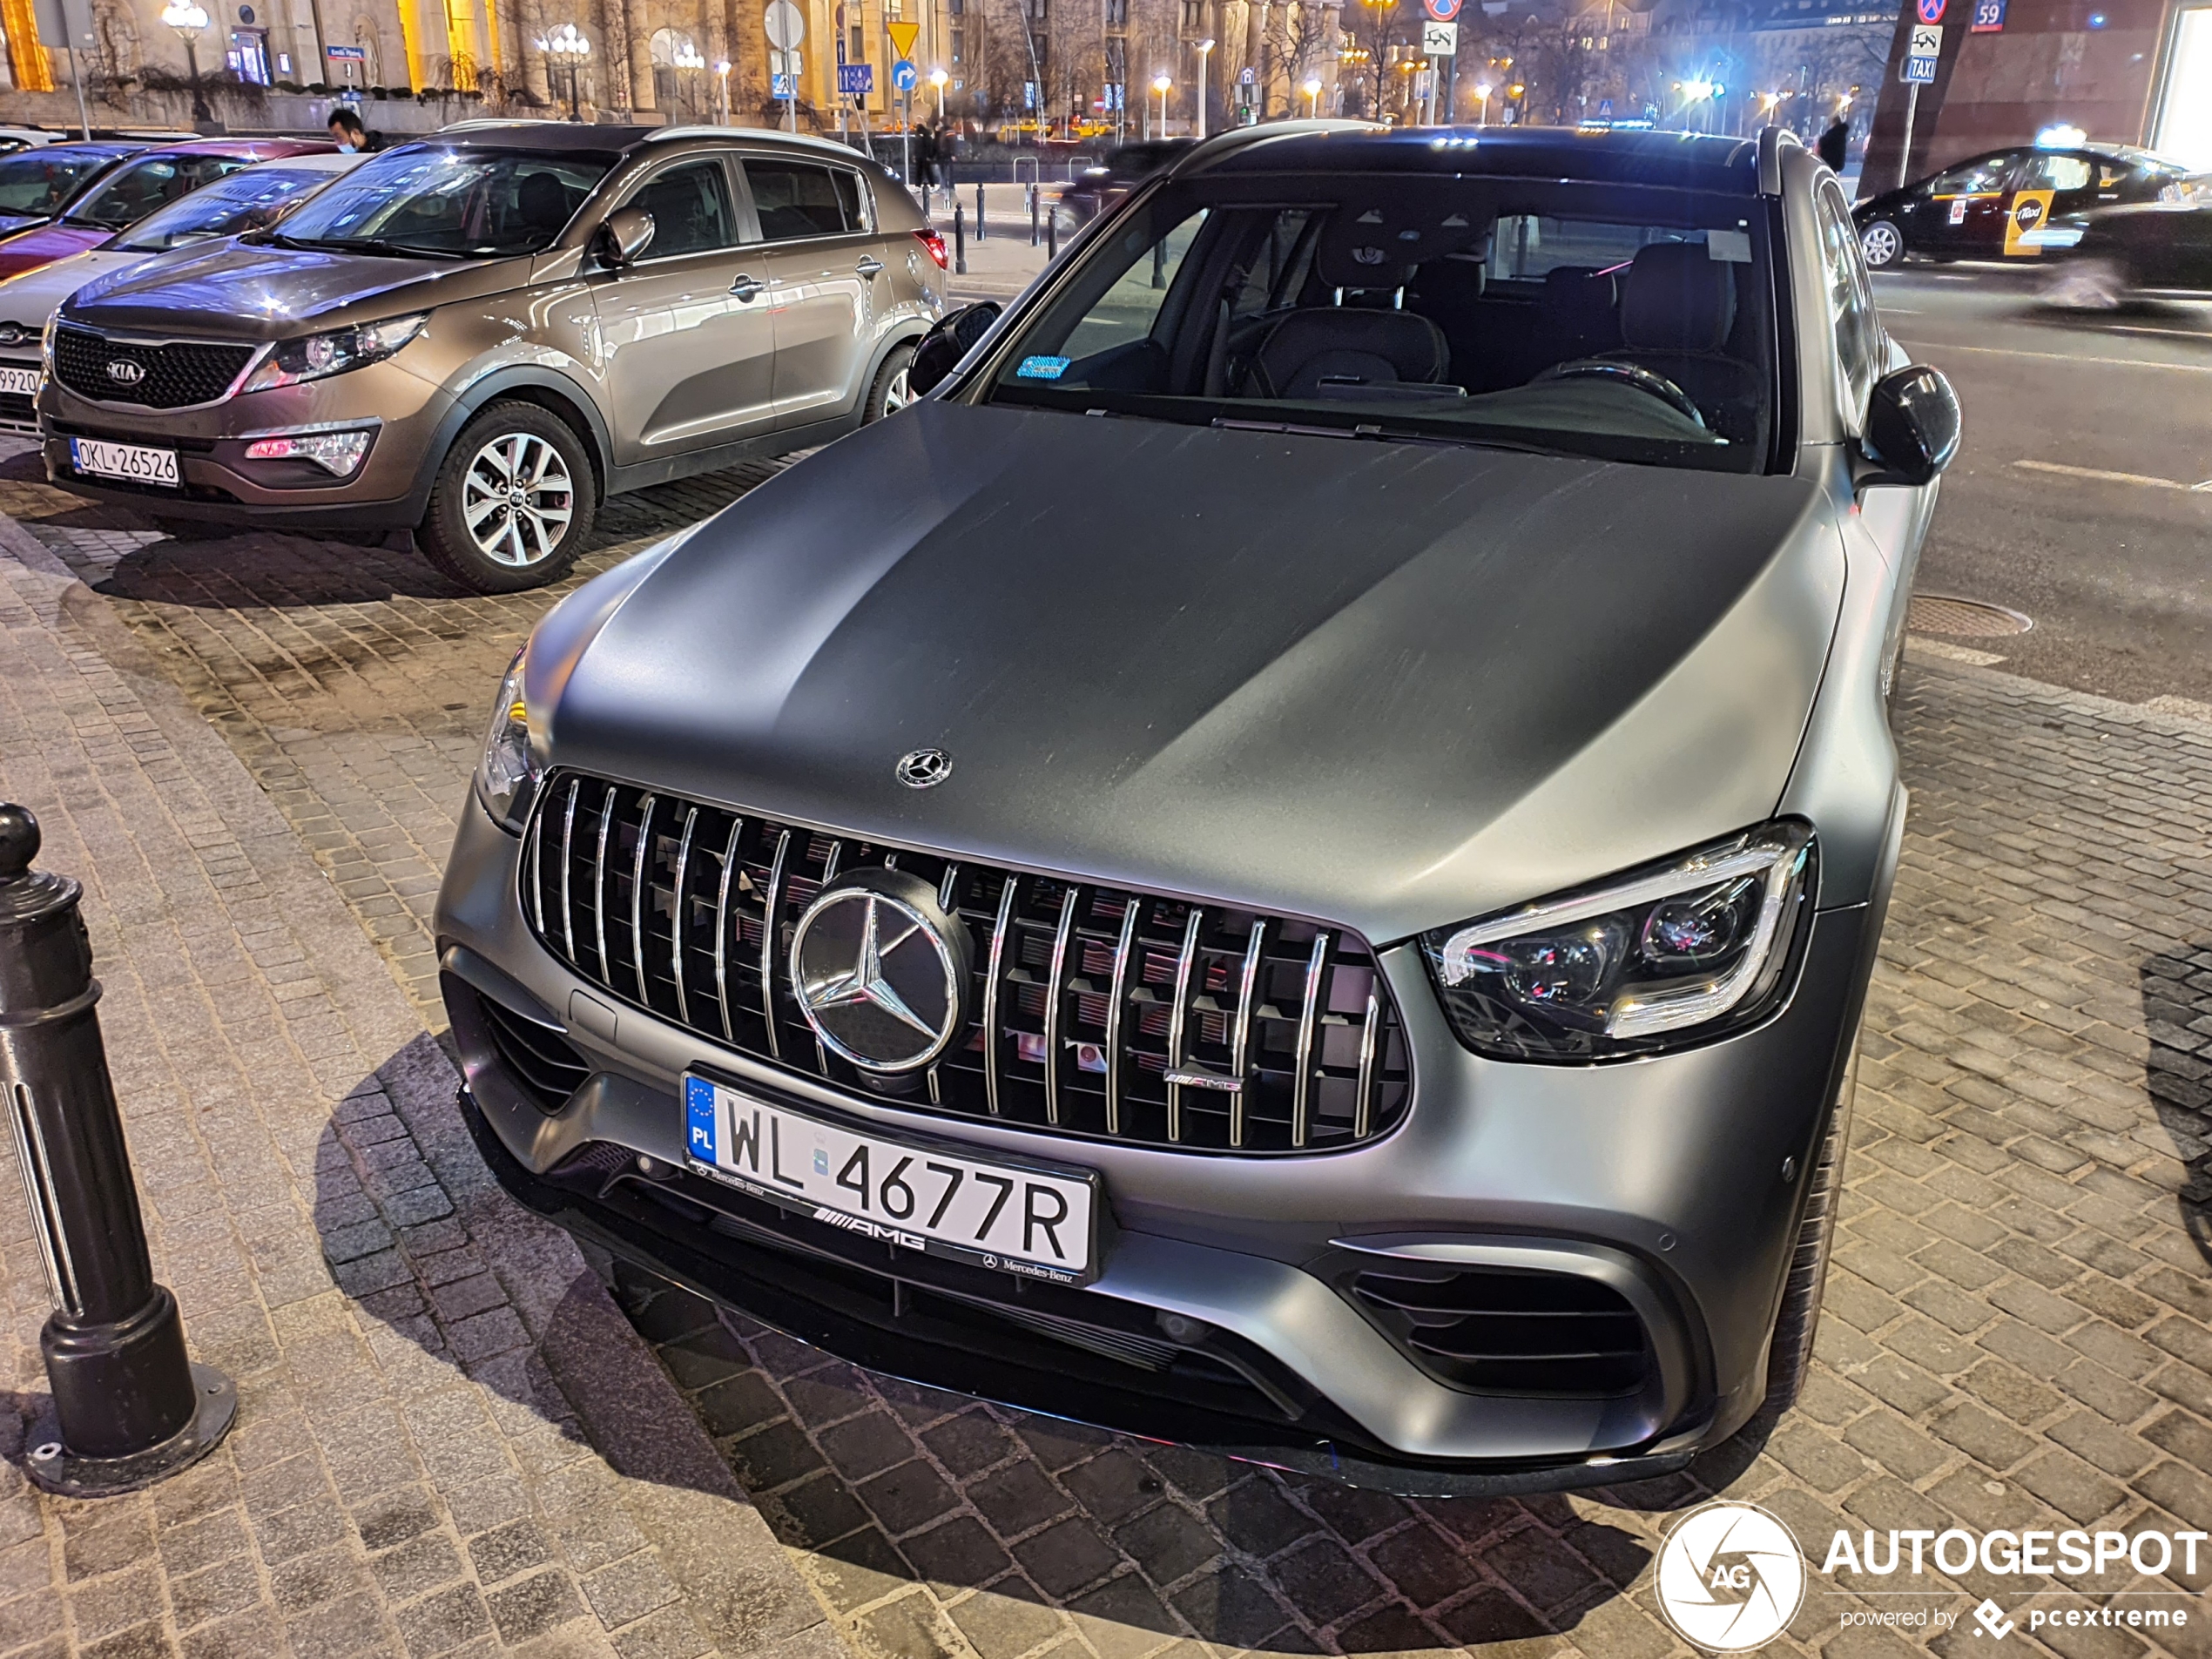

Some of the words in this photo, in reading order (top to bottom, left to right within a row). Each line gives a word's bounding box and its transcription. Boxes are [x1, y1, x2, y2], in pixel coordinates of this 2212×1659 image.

[1978, 4, 2000, 24] 59
[1912, 58, 1935, 78] TAXI
[0, 370, 37, 392] 9920
[111, 363, 136, 381] KIA
[79, 442, 113, 471] OKL
[118, 448, 176, 479] 26526
[692, 1126, 712, 1150] PL
[711, 1170, 765, 1197] Mercedes-Benz
[726, 1096, 804, 1190] WL
[836, 1144, 1069, 1260] 4677R
[847, 1219, 926, 1251] AMG
[1003, 1259, 1073, 1284] Mercedes-Benz
